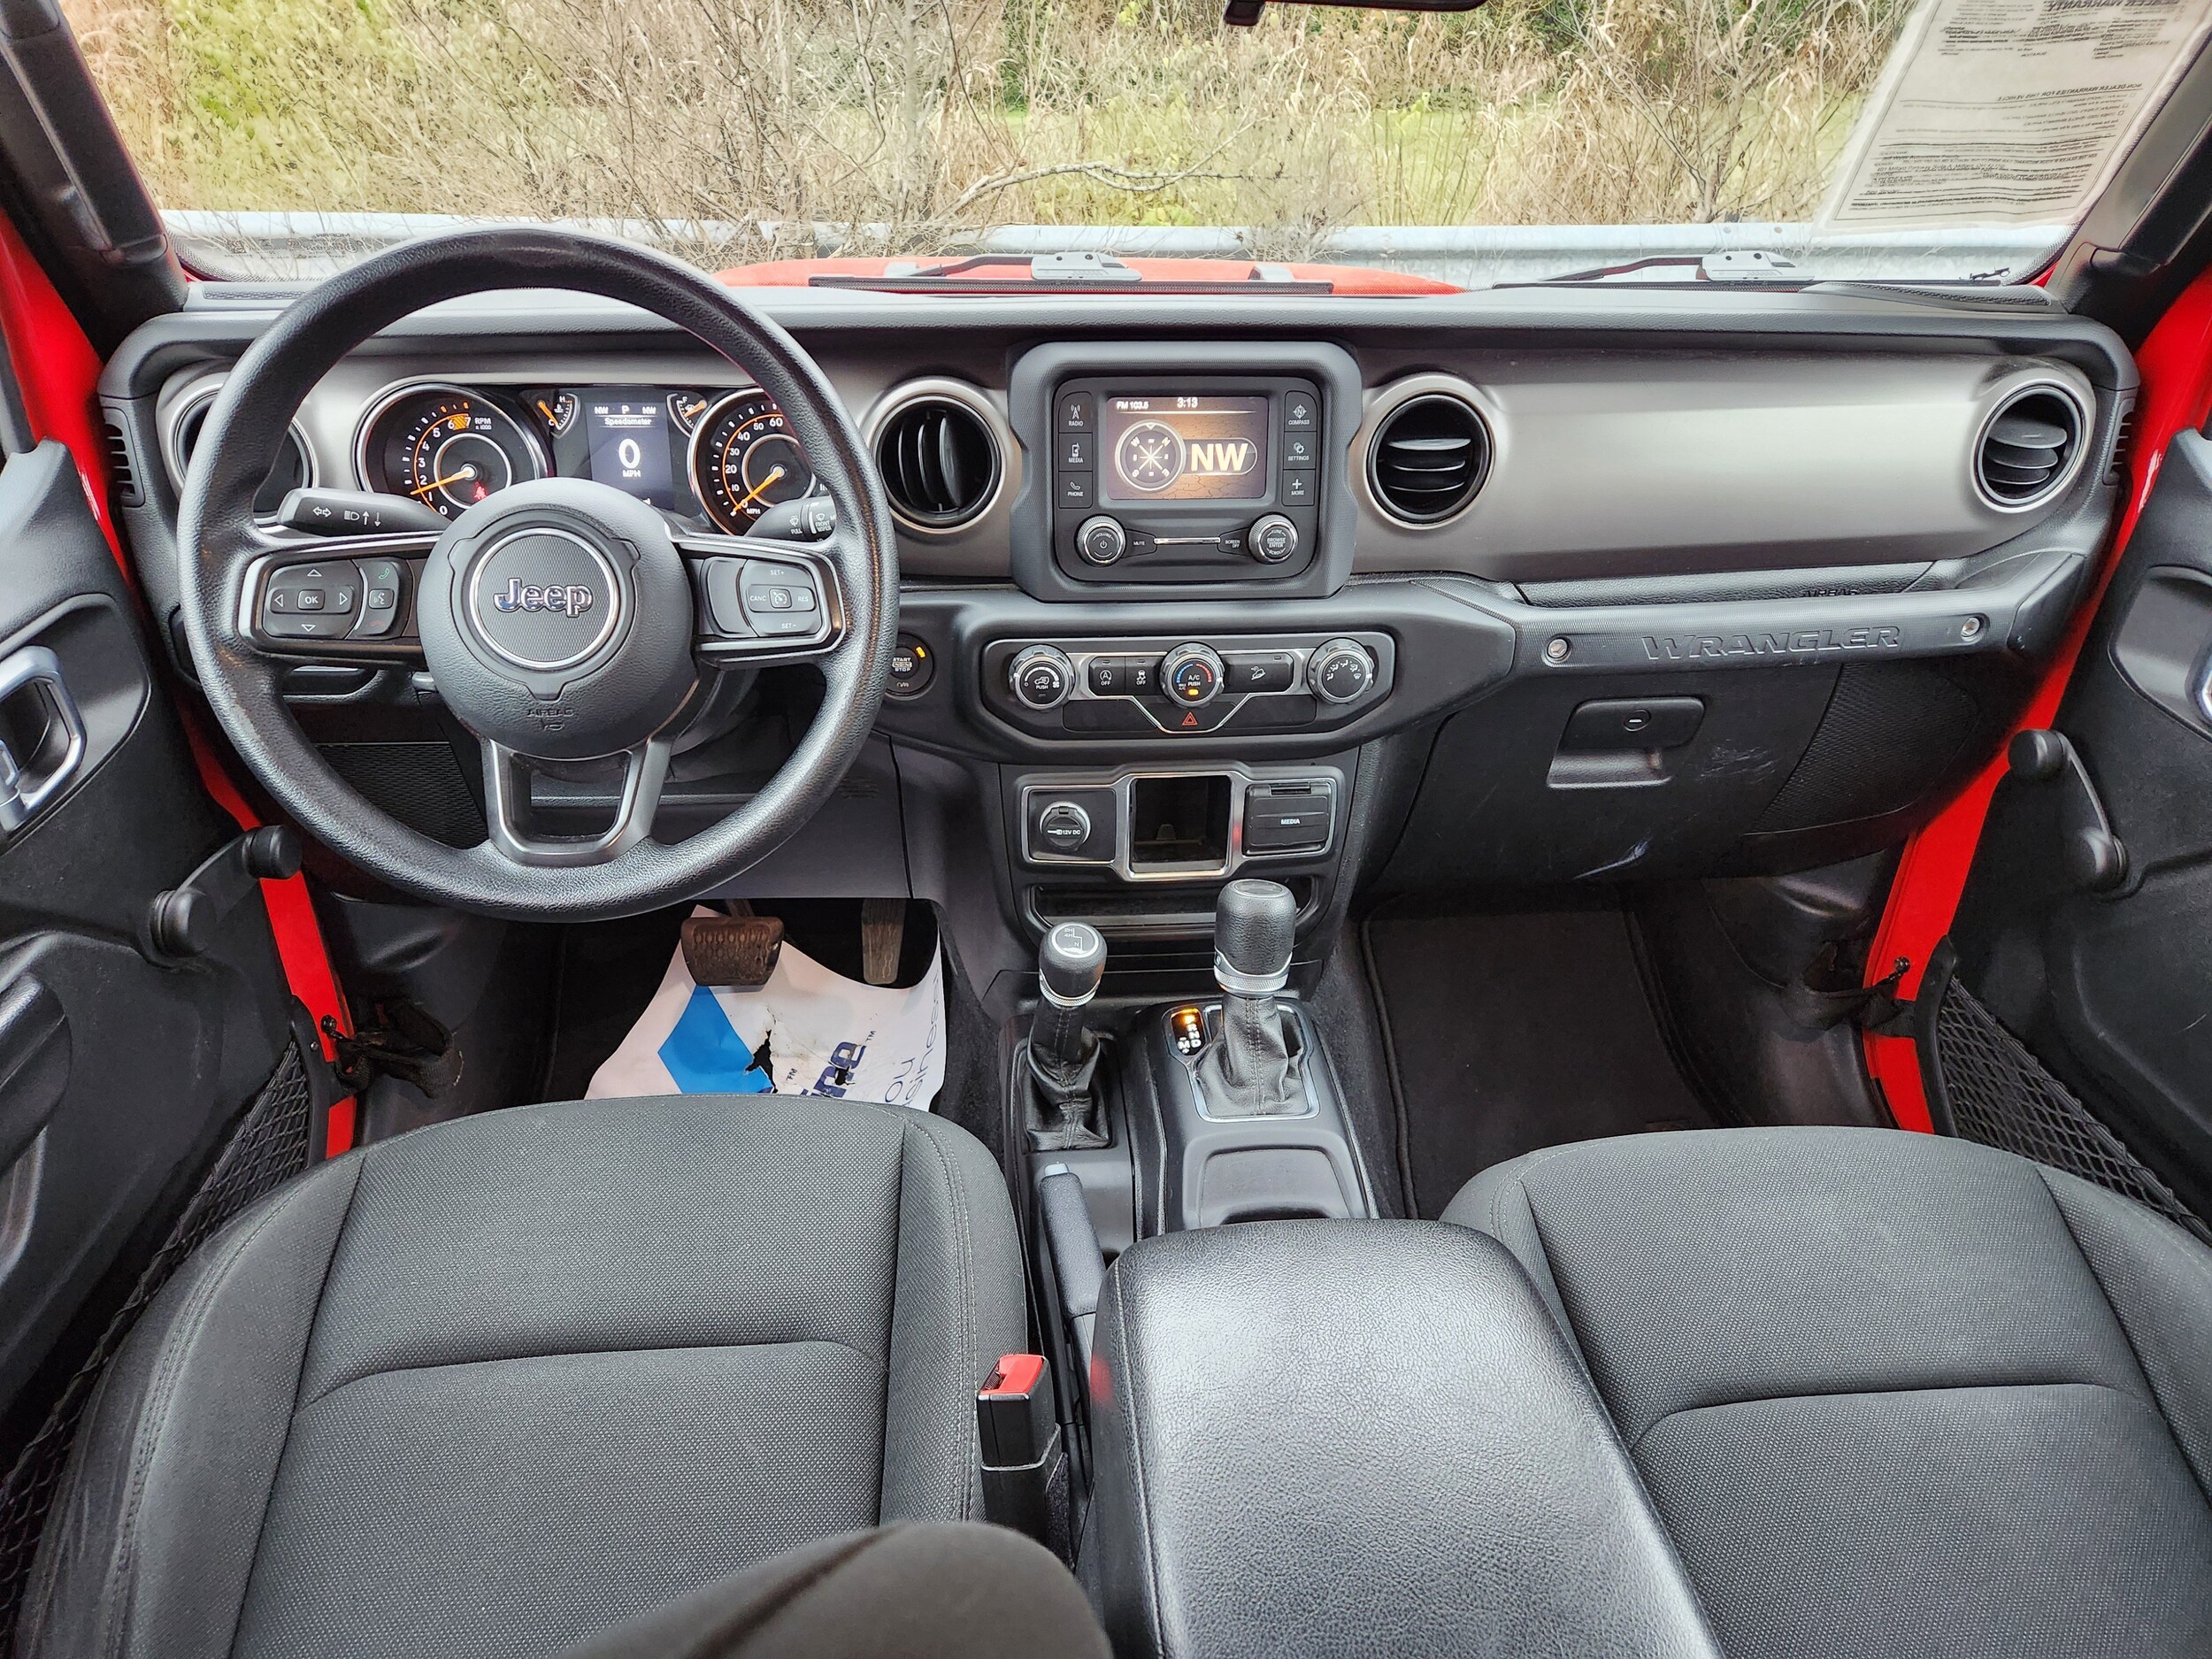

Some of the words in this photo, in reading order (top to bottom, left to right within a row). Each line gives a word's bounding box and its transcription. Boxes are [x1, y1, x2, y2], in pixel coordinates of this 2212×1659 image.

[1177, 397, 1198, 408] 3:13
[621, 405, 630, 414] P
[448, 419, 455, 430] 6
[464, 416, 471, 428] 7
[604, 418, 652, 426] Speedometer
[770, 418, 783, 426] 60
[433, 427, 441, 437] 5
[737, 432, 750, 441] 40
[422, 441, 430, 451] 4
[618, 439, 641, 469] 0
[729, 448, 740, 457] 30
[1191, 443, 1248, 472] NW
[418, 457, 426, 468] 3
[726, 465, 737, 474] 20
[419, 474, 428, 485] 2
[428, 492, 434, 502] 1
[439, 504, 448, 515] 0
[494, 577, 593, 618] Jeep
[1641, 625, 1901, 661] WRANGLER
[526, 708, 574, 718] AIRBAG
[1187, 1023, 1198, 1032] R
[865, 1030, 876, 1042] TM
[1177, 1040, 1191, 1049] M
[1191, 1039, 1202, 1048] D
[786, 1067, 798, 1081] TM
